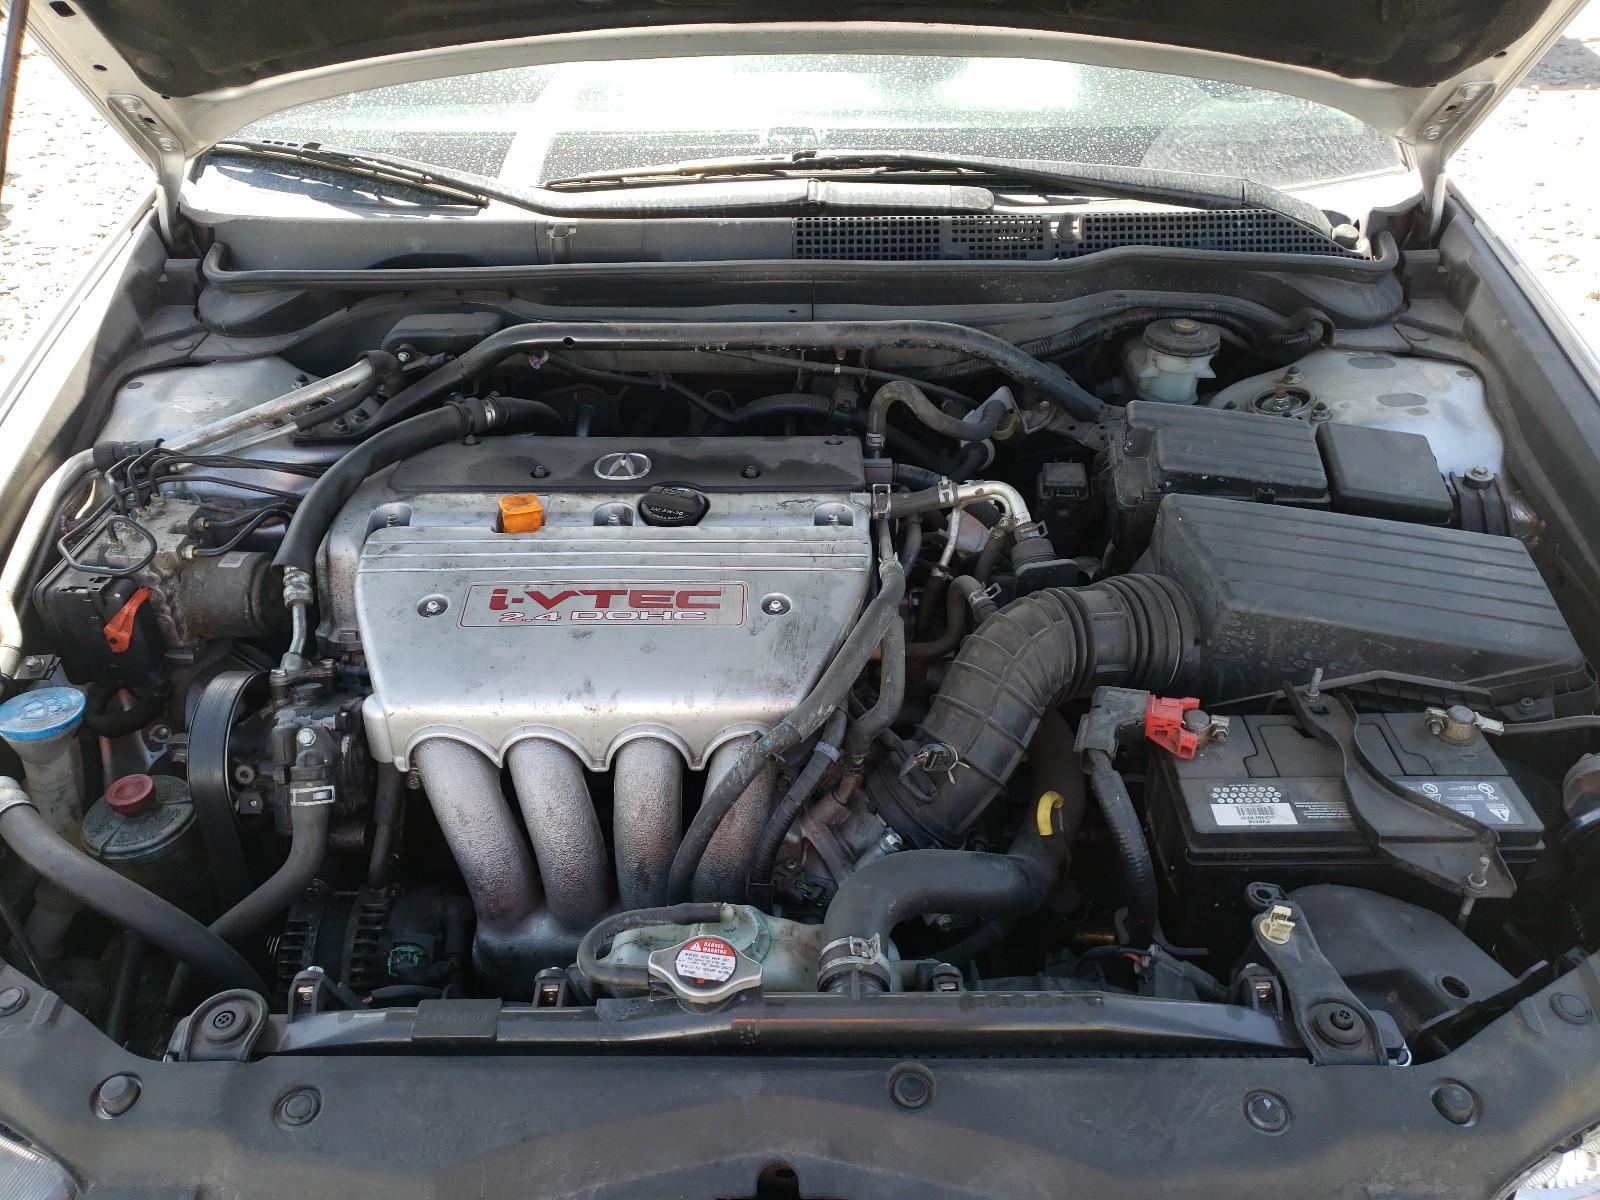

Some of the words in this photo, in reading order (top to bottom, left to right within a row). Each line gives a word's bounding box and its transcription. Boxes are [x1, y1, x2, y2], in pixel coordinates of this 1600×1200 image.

[489, 588, 722, 611] i-VTEC
[499, 610, 562, 622] 2.4
[570, 610, 707, 621] DOHC
[703, 941, 725, 950] DANGER
[702, 947, 728, 955] WARNING
